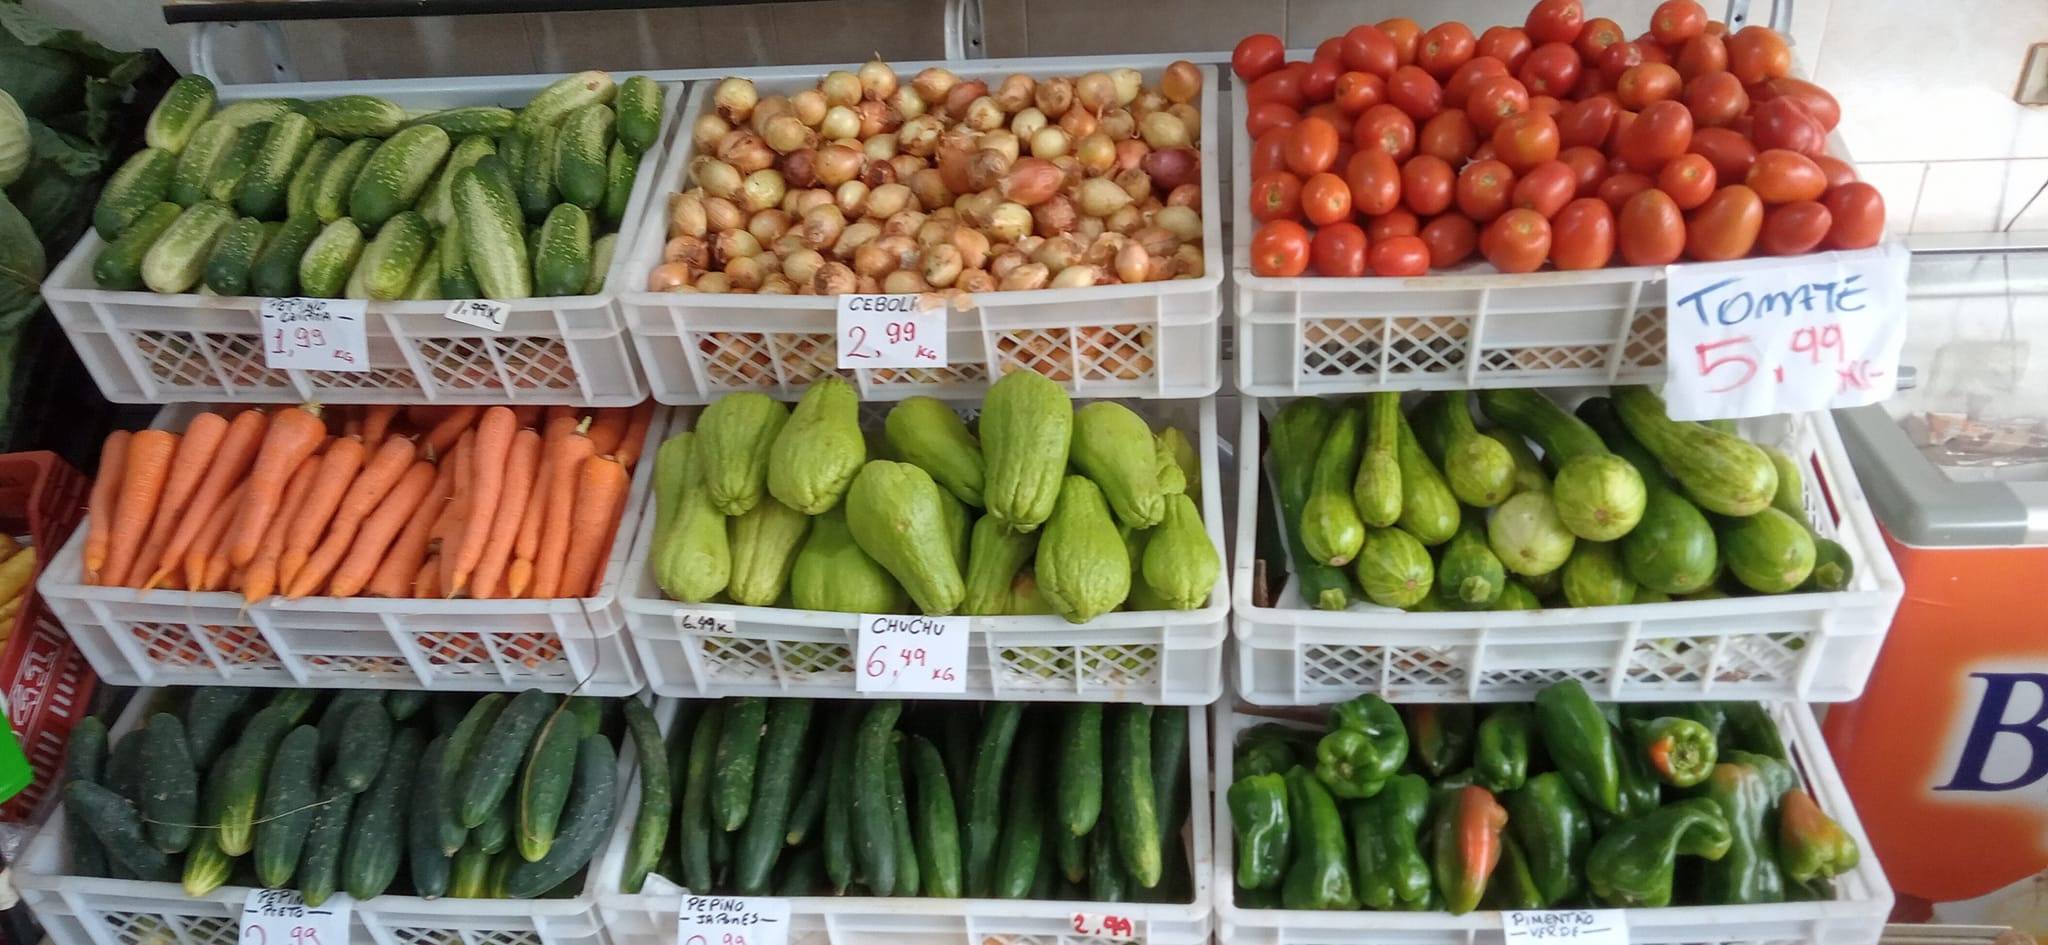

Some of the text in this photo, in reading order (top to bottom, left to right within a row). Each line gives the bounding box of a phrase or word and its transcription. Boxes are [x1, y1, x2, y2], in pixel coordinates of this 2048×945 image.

[848, 296, 920, 312] CEBOL
[1676, 274, 1869, 326] TOMATE
[272, 327, 326, 357] 1,99
[847, 321, 916, 358] 2,99
[871, 617, 945, 636] CHUCHU
[866, 645, 926, 677] 6,49
[258, 889, 306, 905] PEPIN
[687, 896, 744, 912] PEPINO
